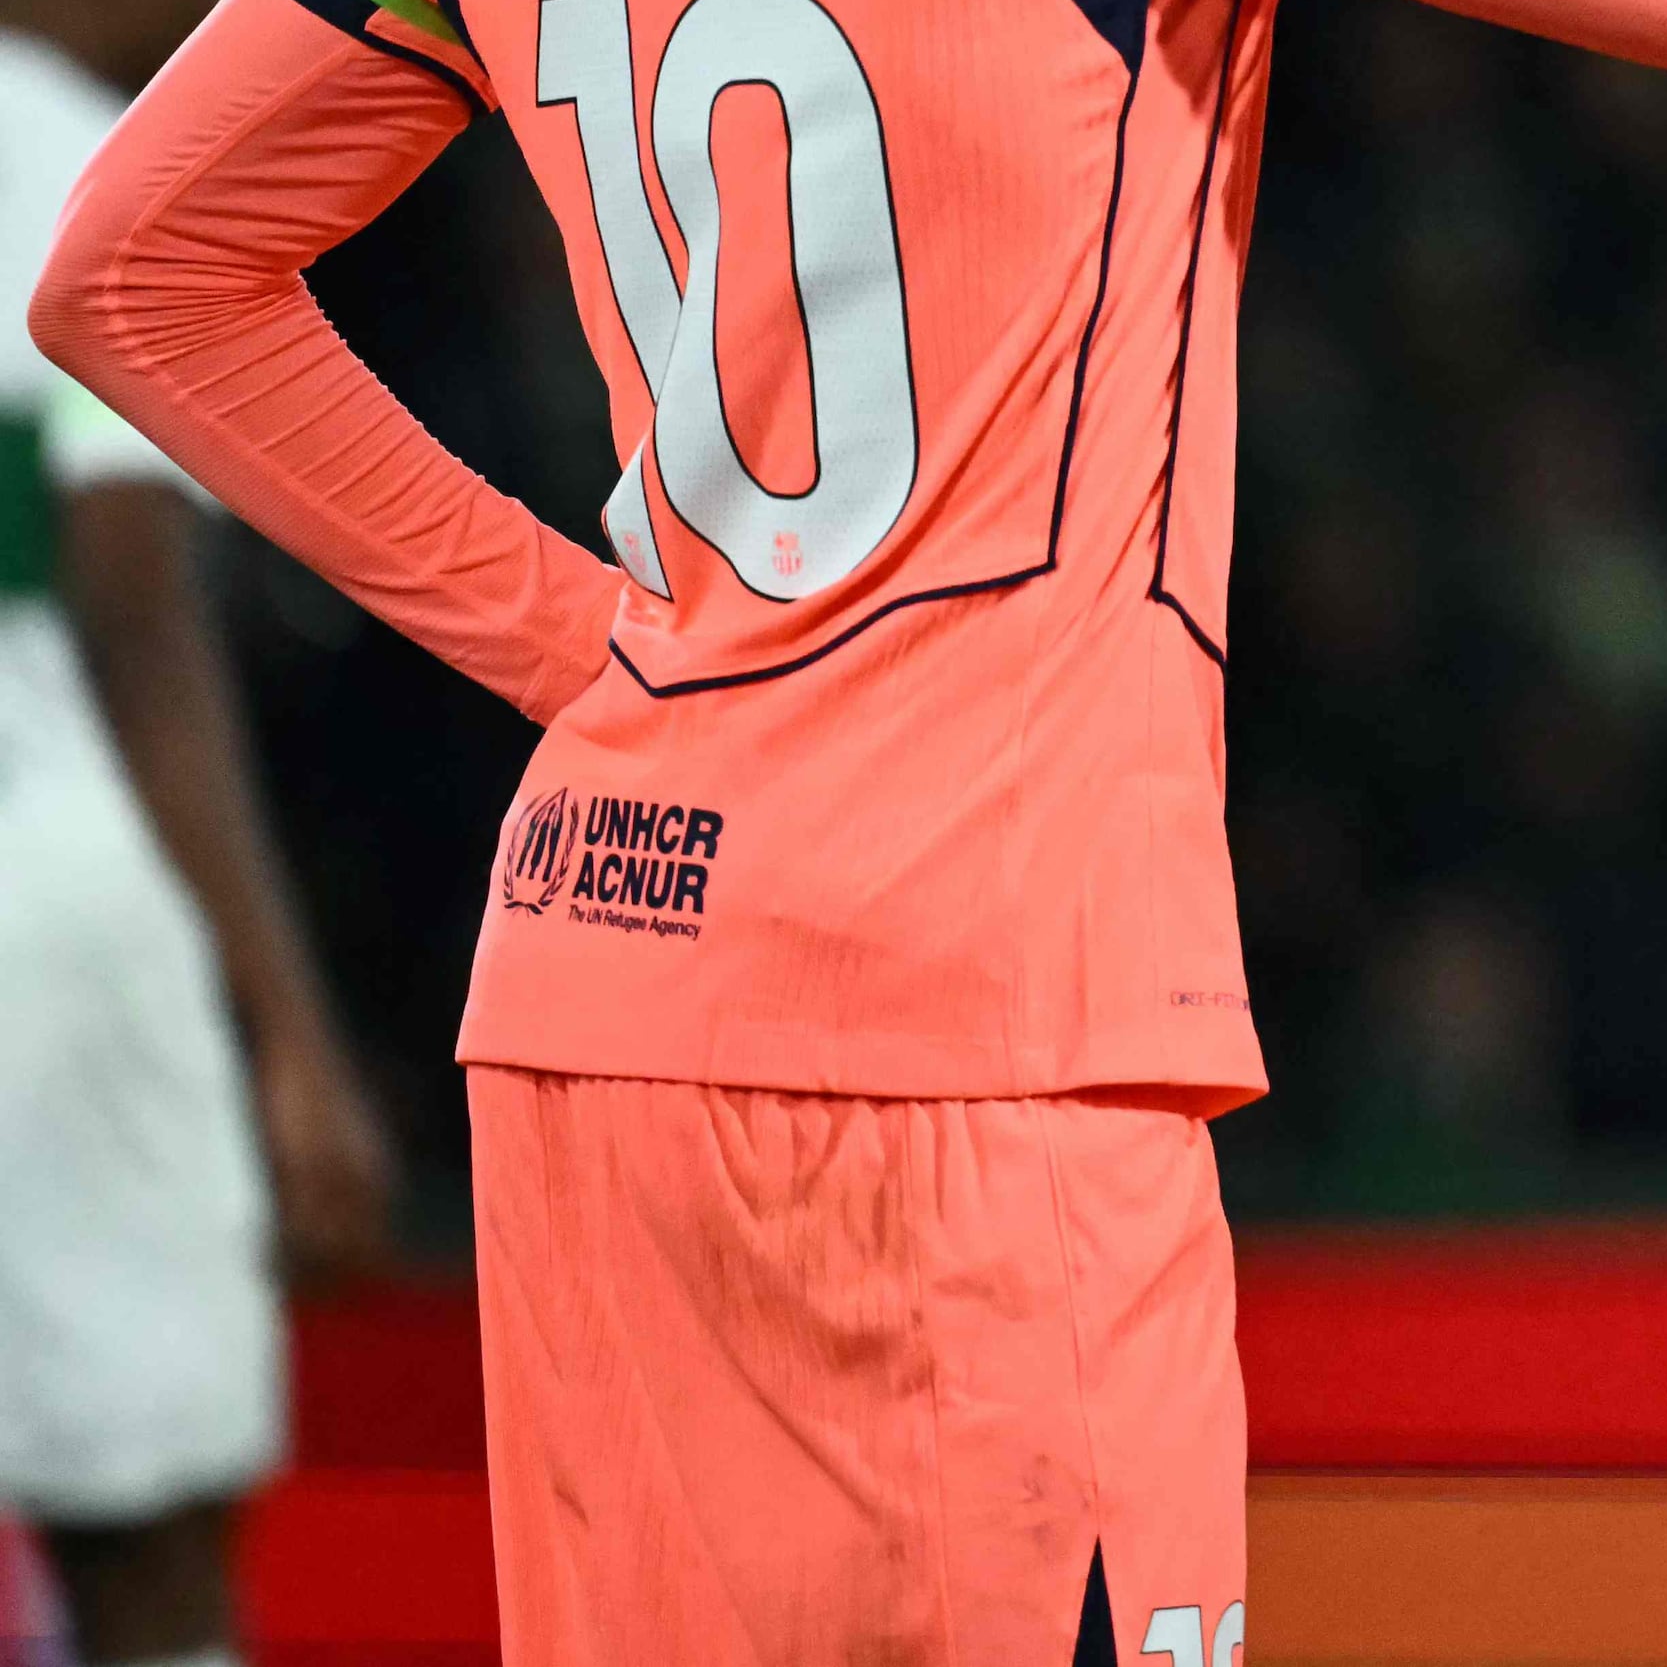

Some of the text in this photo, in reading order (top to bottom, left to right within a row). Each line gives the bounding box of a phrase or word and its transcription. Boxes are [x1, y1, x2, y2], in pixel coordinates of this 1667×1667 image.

[584, 796, 724, 859] UNHCR
[572, 851, 709, 914] ACNUR
[649, 915, 701, 941] Agency
